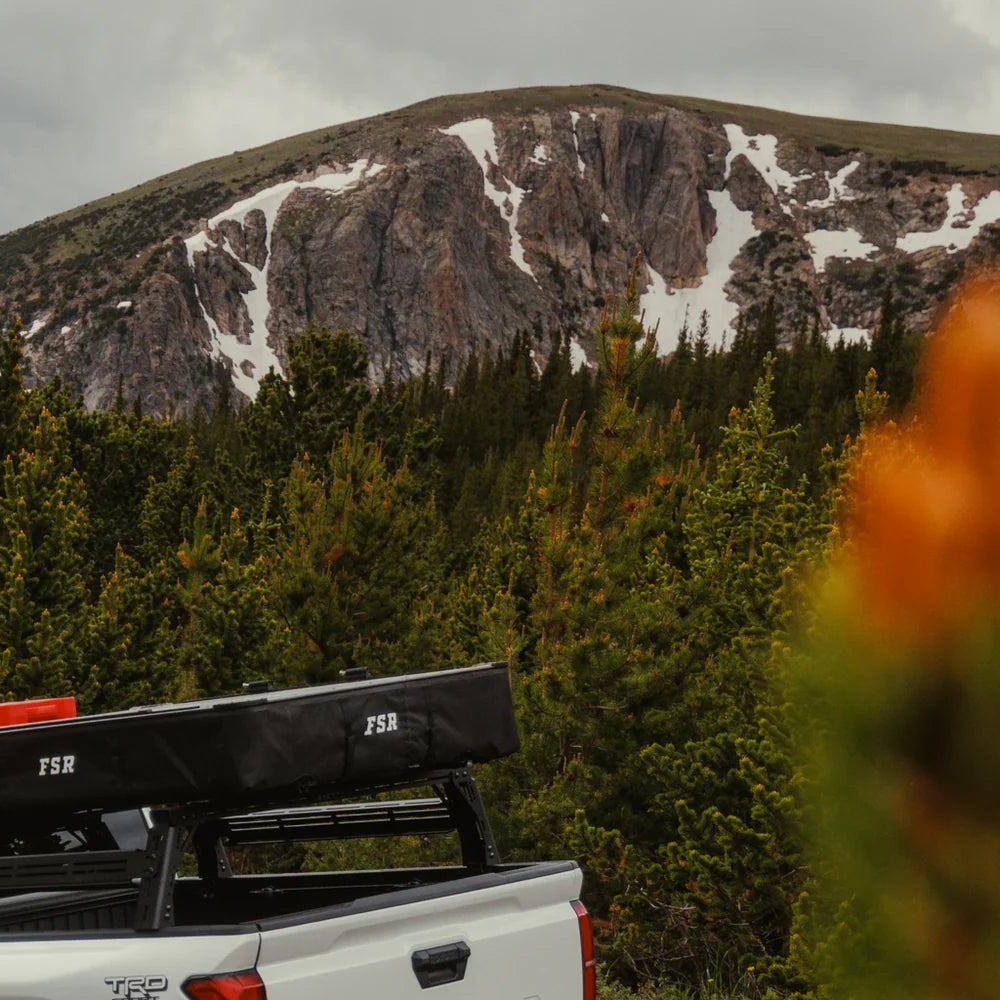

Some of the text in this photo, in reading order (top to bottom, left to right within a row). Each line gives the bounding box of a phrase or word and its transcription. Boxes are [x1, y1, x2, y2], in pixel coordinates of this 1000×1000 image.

[364, 712, 398, 736] FSR
[39, 755, 75, 776] FSR
[104, 975, 168, 998] TRD
